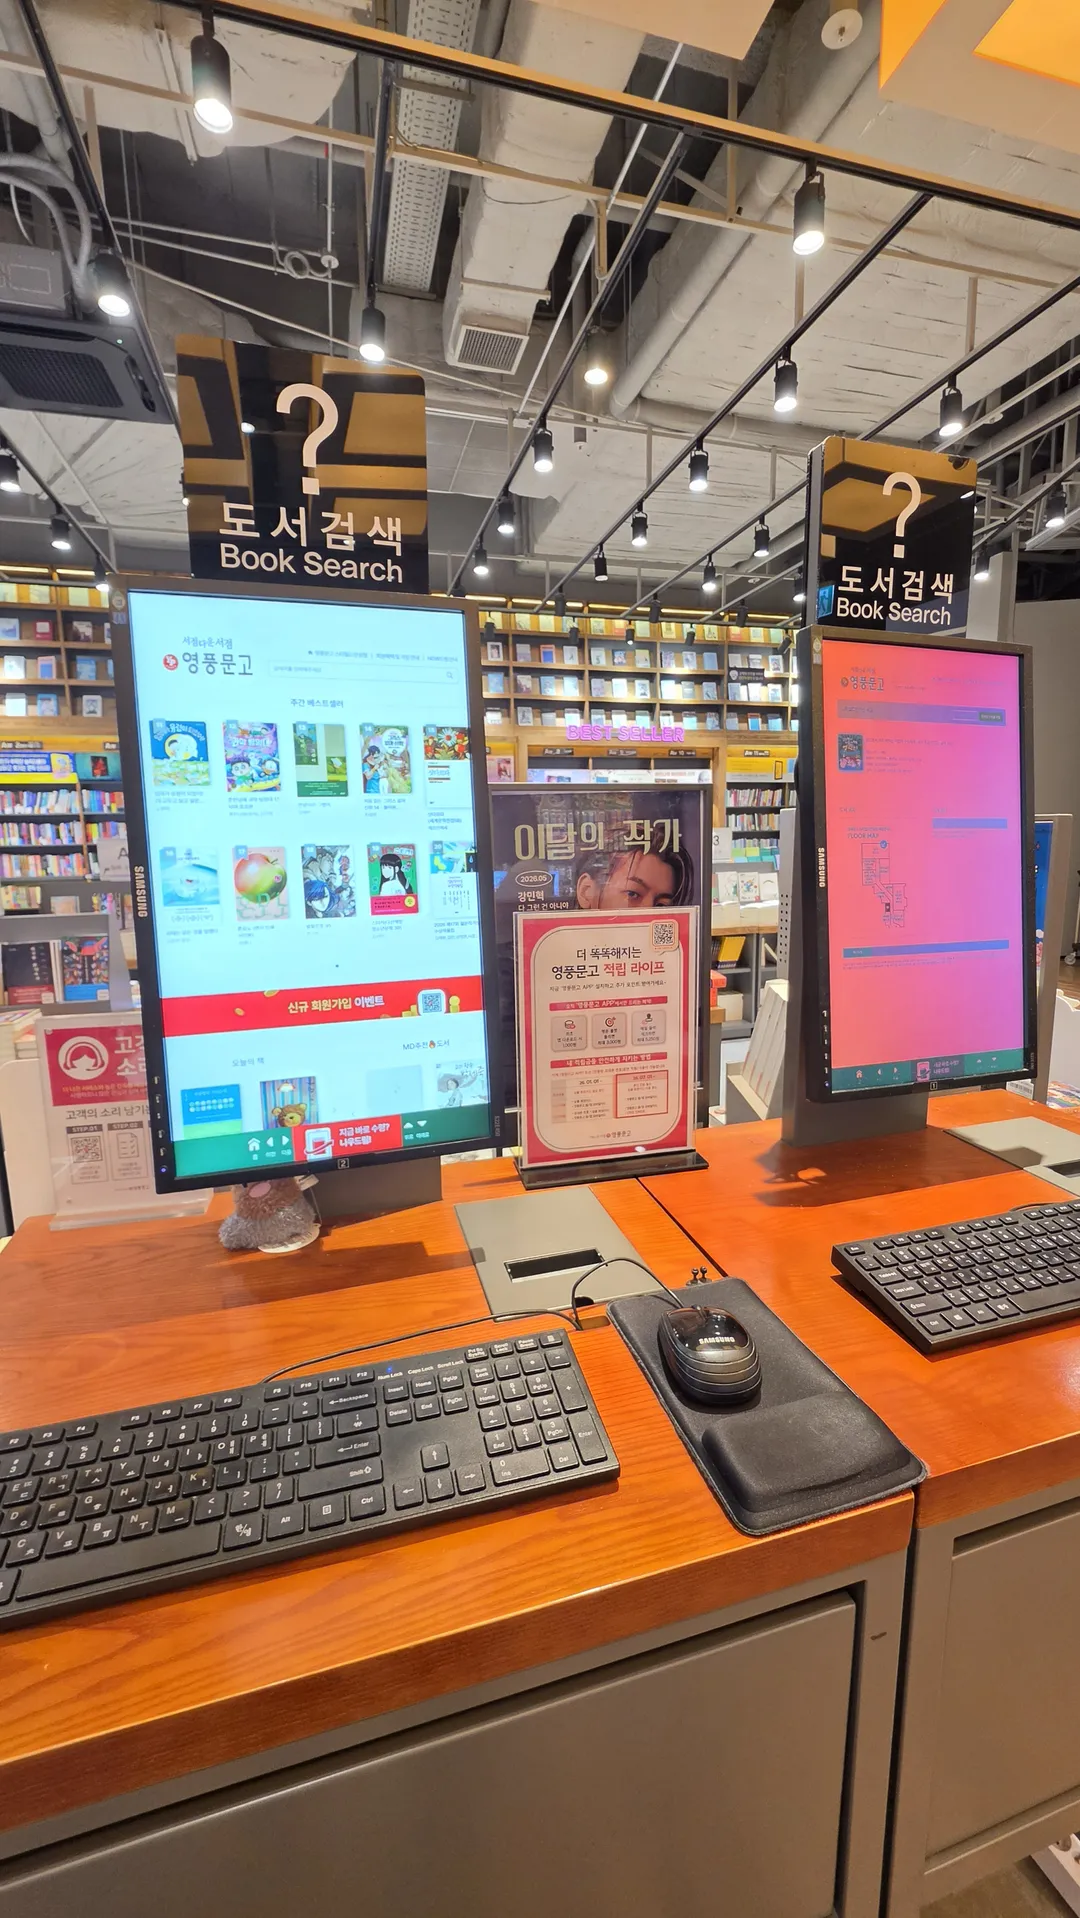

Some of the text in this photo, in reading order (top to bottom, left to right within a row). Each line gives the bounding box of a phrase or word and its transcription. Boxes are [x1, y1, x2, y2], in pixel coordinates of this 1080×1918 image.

[219, 502, 402, 557] 도서검색
[220, 543, 403, 584] Book Search
[838, 565, 954, 605] 도서검색
[836, 597, 951, 626] Book Search
[182, 652, 253, 676] 영풍문고
[850, 676, 885, 691] 영풍문고
[291, 698, 344, 708] 주간 베스트셀러
[566, 725, 685, 742] BEST SELLER
[514, 819, 683, 861] 이달의 작가
[818, 848, 826, 888] SAMSUNG
[134, 866, 148, 918] SAMSUNG
[518, 890, 545, 903] 강민혁
[542, 903, 548, 911] 건
[550, 902, 569, 910] 아니야
[577, 947, 642, 961] 더 똑똑해지는
[552, 961, 665, 980] 영풍문고 적립 라이프
[288, 995, 385, 1014] 신규 회원가입 이벤트
[66, 1108, 98, 1120] 고객의
[100, 1107, 121, 1118] 소리
[339, 1128, 354, 1137] 지금
[355, 1126, 371, 1135] 바로
[698, 1336, 736, 1345] SAMSUNG
[447, 1397, 463, 1405] PgDn
[389, 1409, 408, 1417] Delete
[353, 1441, 370, 1450] Enter
[281, 1516, 291, 1524] Alt
